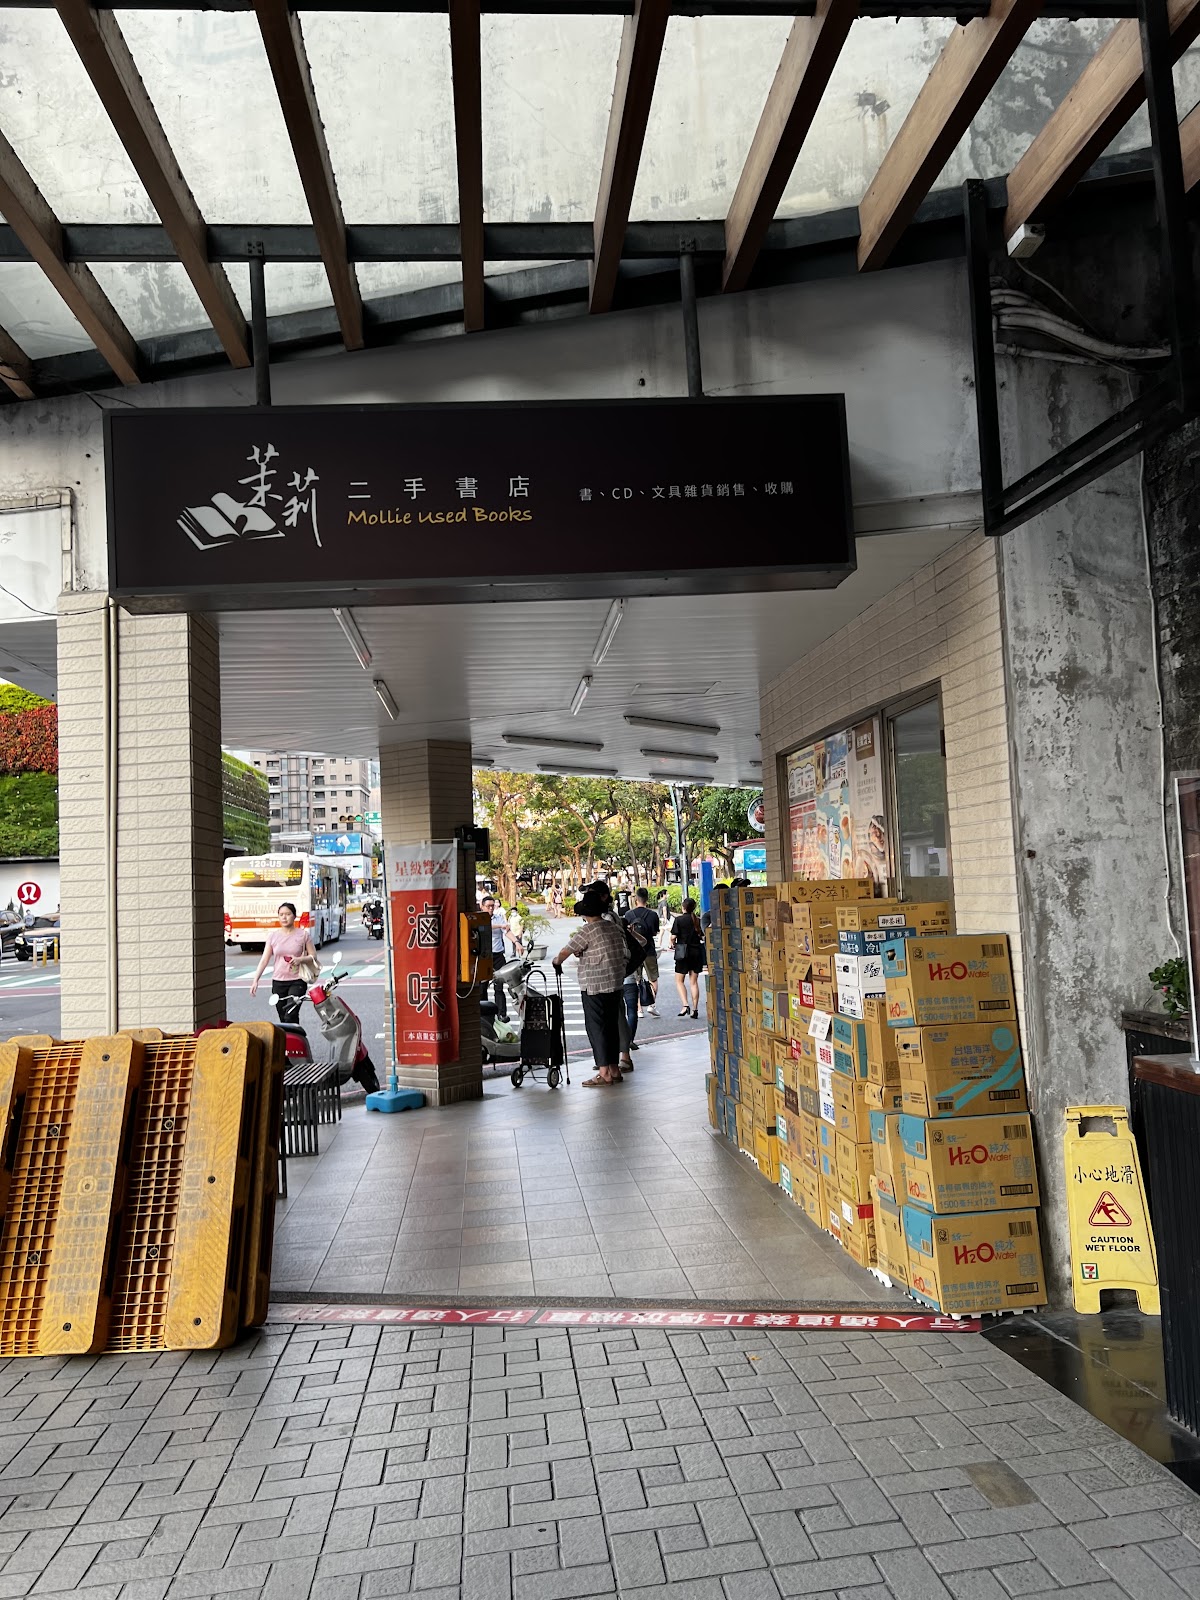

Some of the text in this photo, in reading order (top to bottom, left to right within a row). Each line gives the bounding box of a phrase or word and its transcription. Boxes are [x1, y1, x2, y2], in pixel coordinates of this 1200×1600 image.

[238, 443, 323, 548] 茉莉
[348, 475, 530, 500] 二手書店
[347, 507, 412, 525] Mollie
[471, 506, 533, 522] Books
[406, 902, 446, 1017] 滷味
[1073, 1165, 1135, 1185] 小心地滑
[1085, 1244, 1141, 1252] WET FLOOR
[1090, 1236, 1135, 1244] CAUTION
